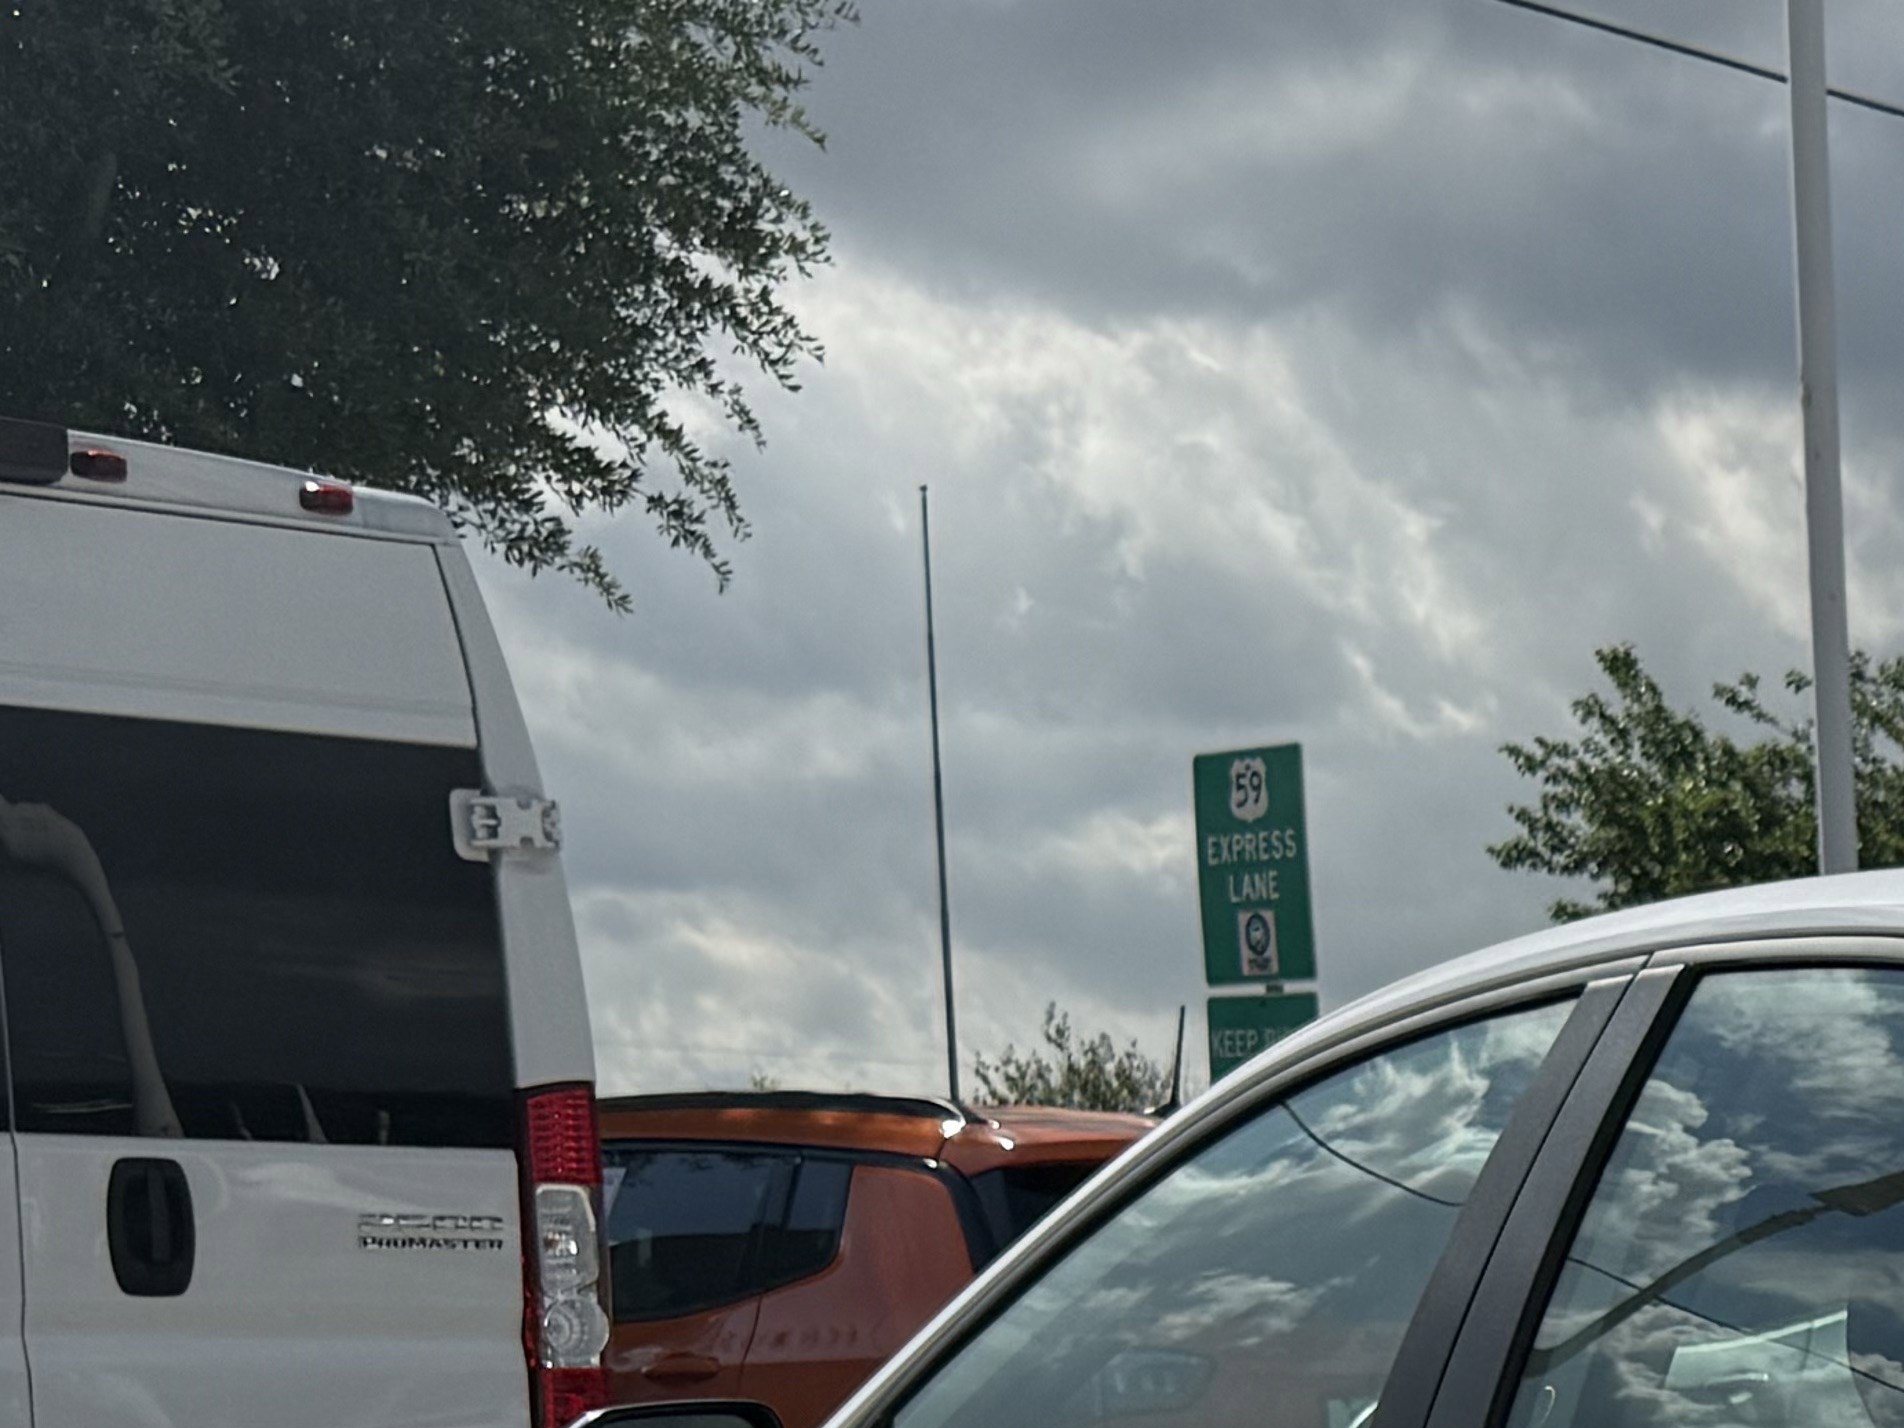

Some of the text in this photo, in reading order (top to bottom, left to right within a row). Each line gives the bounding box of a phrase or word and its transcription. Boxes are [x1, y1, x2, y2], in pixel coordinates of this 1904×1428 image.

[1234, 770, 1262, 809] 59
[1206, 828, 1298, 867] EXPRESS
[1228, 870, 1281, 904] LANE
[1210, 1027, 1258, 1058] KEEP
